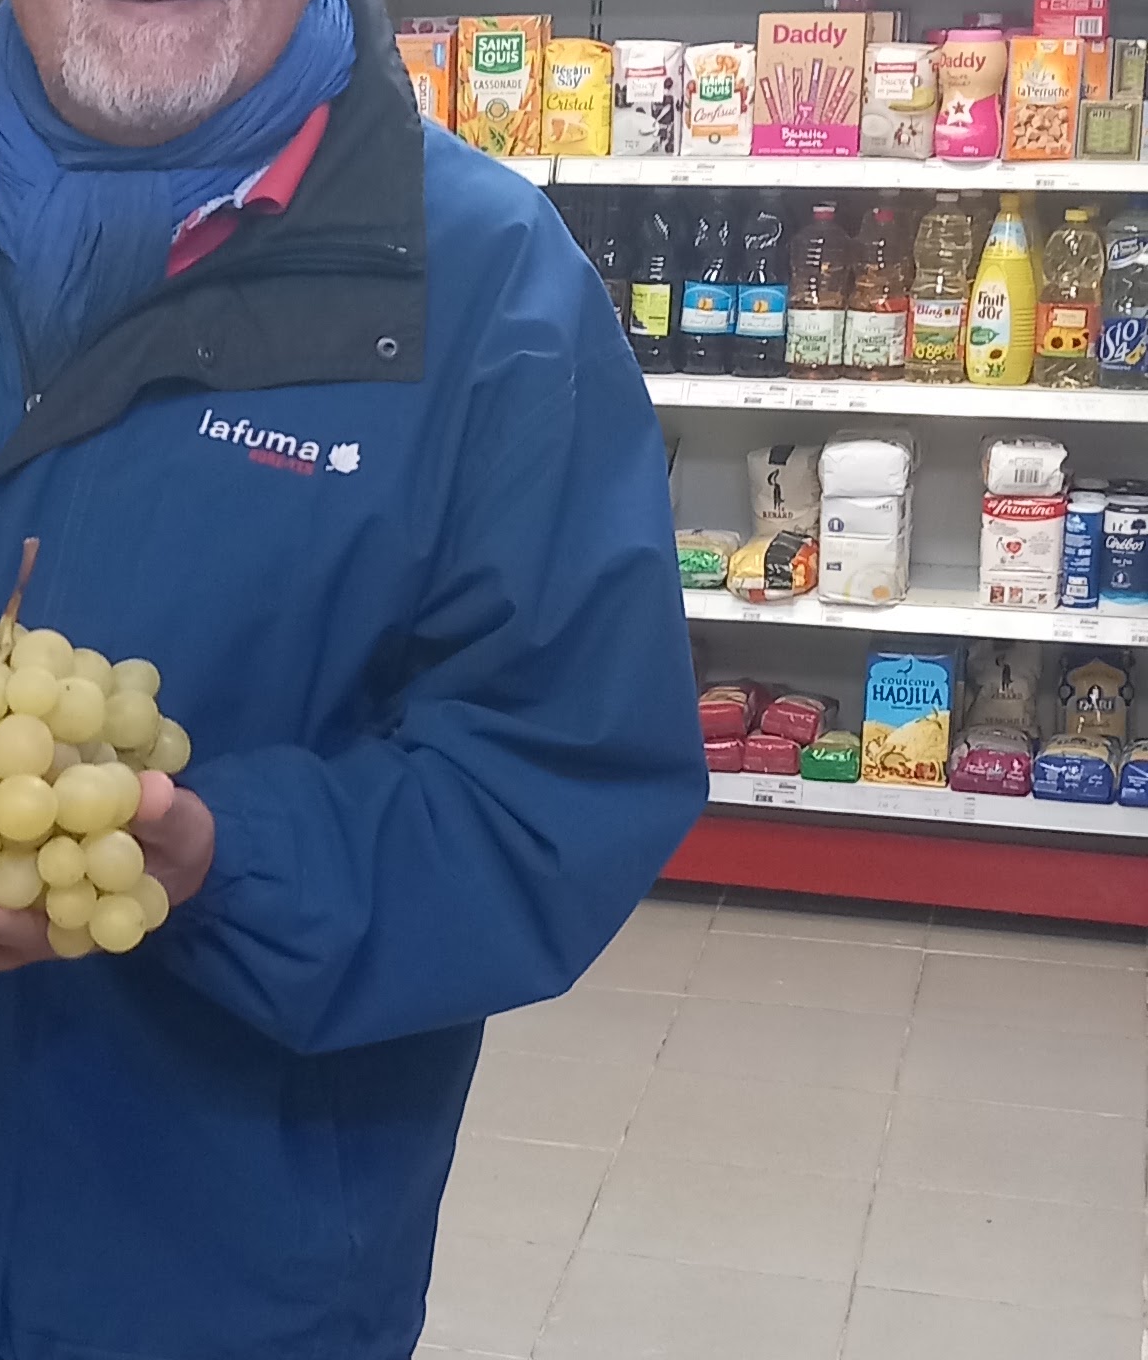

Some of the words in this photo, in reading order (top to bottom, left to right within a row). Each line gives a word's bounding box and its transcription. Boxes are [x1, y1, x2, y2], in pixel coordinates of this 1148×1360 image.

[772, 21, 848, 48] Daddy
[478, 37, 520, 52] SAINT
[478, 49, 519, 67] LOUIS
[939, 52, 987, 71] Daddy
[473, 78, 523, 90] CASSONADE
[546, 93, 595, 112] Cristal
[977, 291, 1007, 306] Fruit
[977, 305, 1004, 320] d'Or
[198, 408, 320, 463] lafuma
